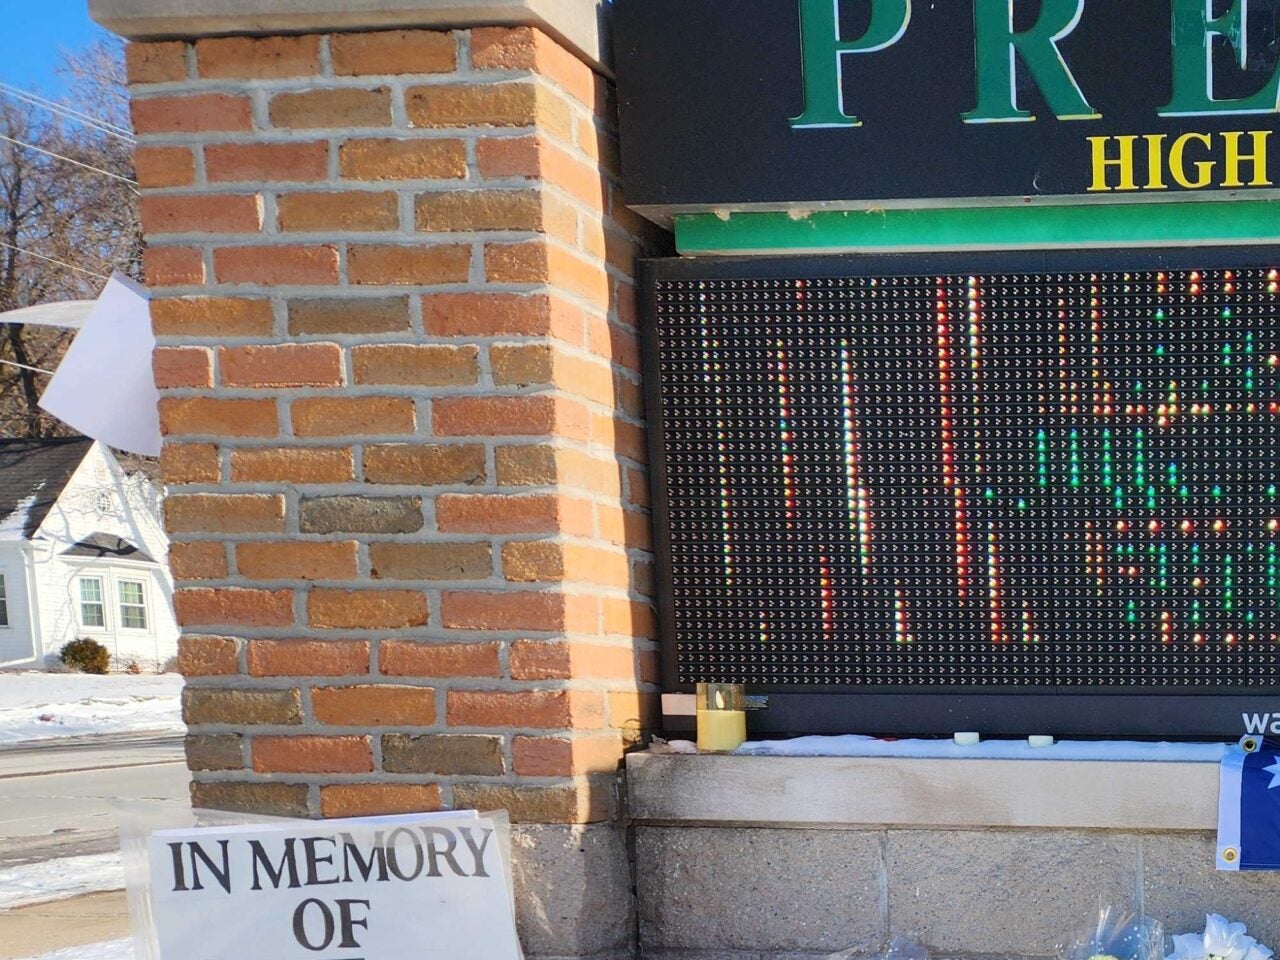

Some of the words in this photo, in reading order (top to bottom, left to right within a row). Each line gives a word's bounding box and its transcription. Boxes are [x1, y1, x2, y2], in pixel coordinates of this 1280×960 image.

[1086, 131, 1275, 191] HIGH
[167, 840, 231, 894] IN
[247, 826, 494, 892] MEMORY
[292, 898, 371, 951] OF
